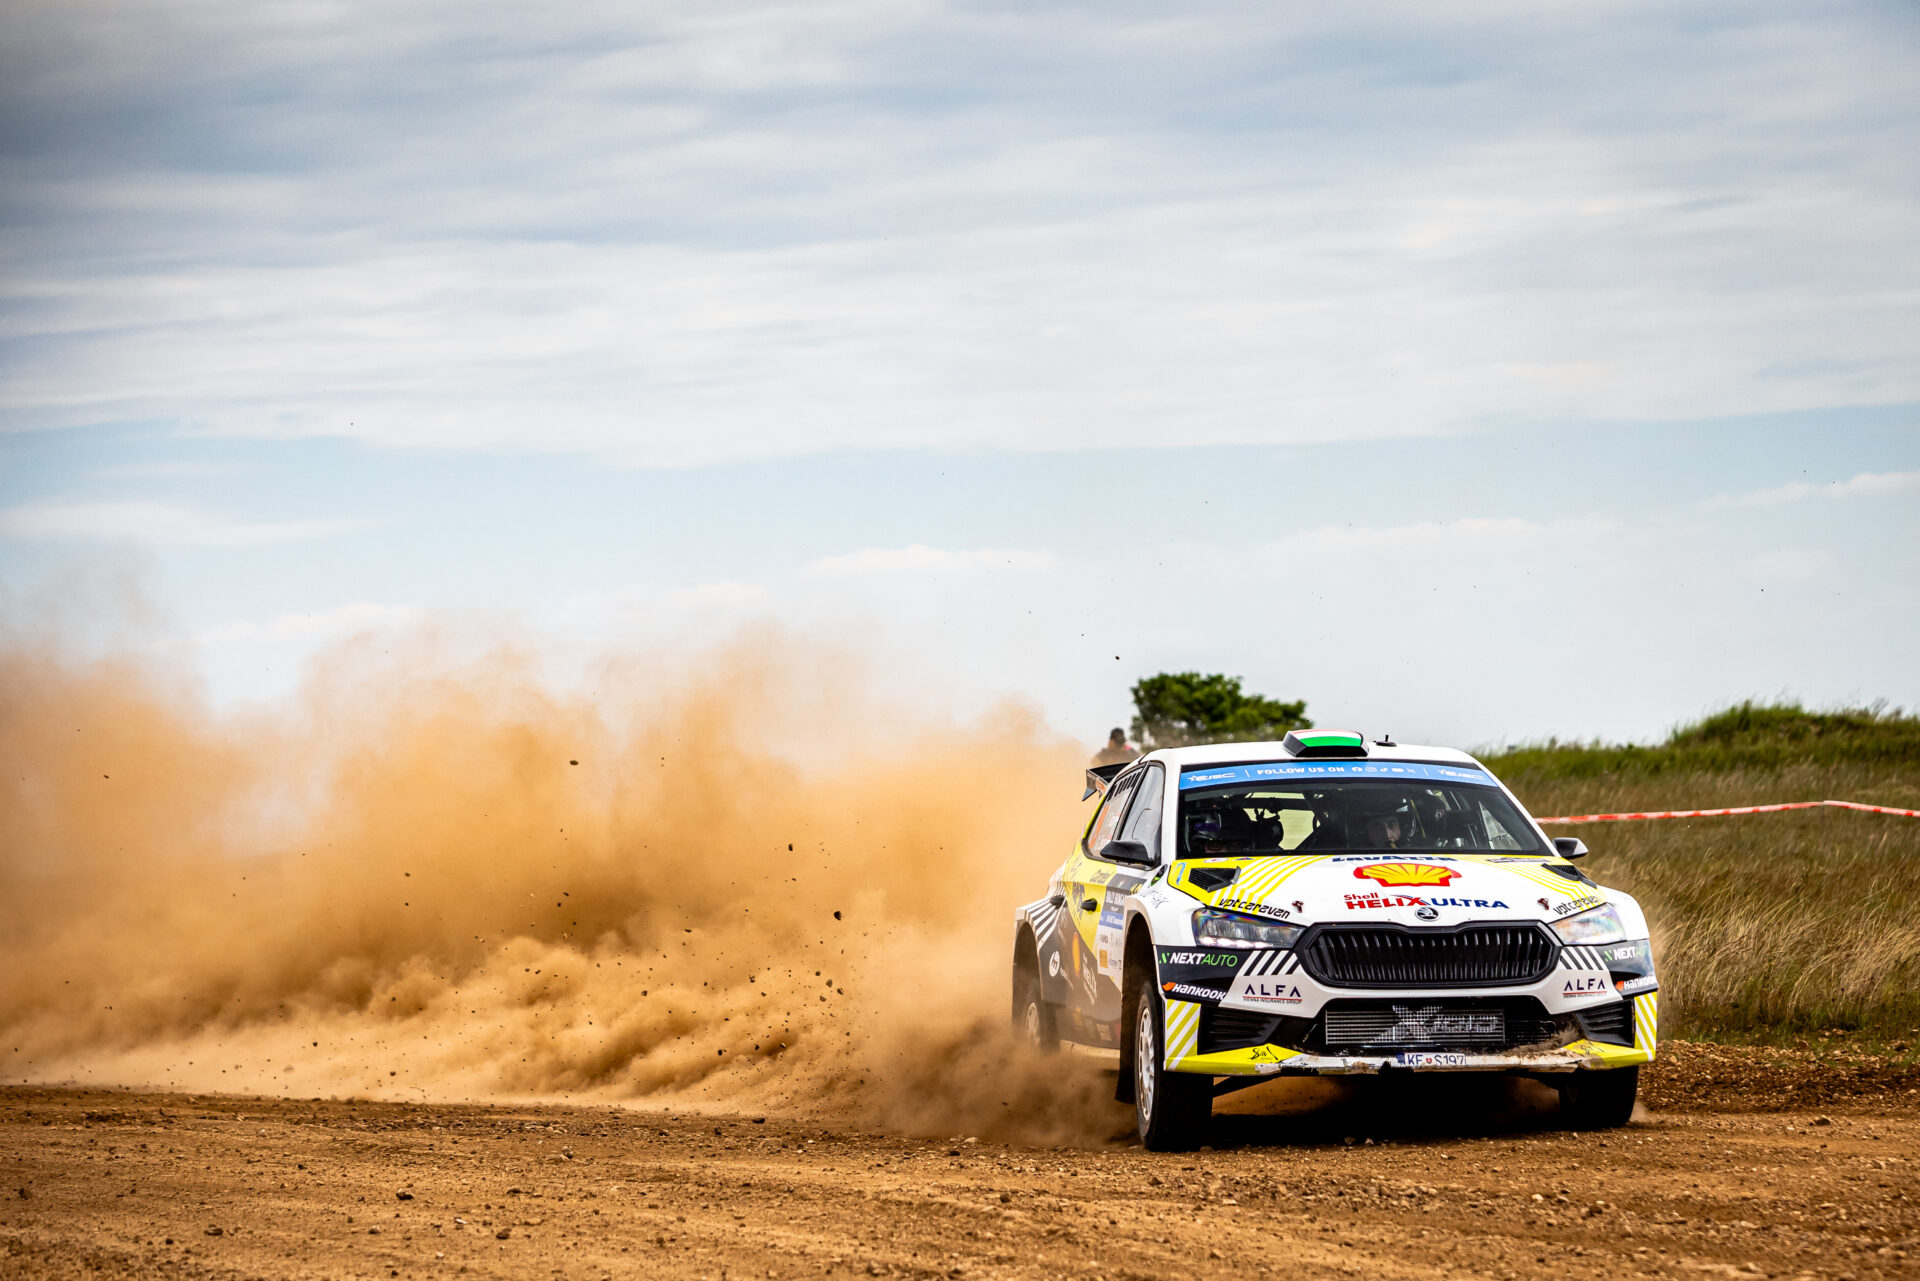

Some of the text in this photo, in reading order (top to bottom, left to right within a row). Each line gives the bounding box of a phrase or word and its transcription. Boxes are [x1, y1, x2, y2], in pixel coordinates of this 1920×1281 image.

[1256, 767, 1305, 776] FOLLOW
[1343, 892, 1379, 901] Shell
[1344, 896, 1510, 910] HELIX ULTRA
[1169, 952, 1238, 967] NEXTAUTO
[1244, 983, 1302, 998] ALFA
[1564, 978, 1606, 992] ALFA
